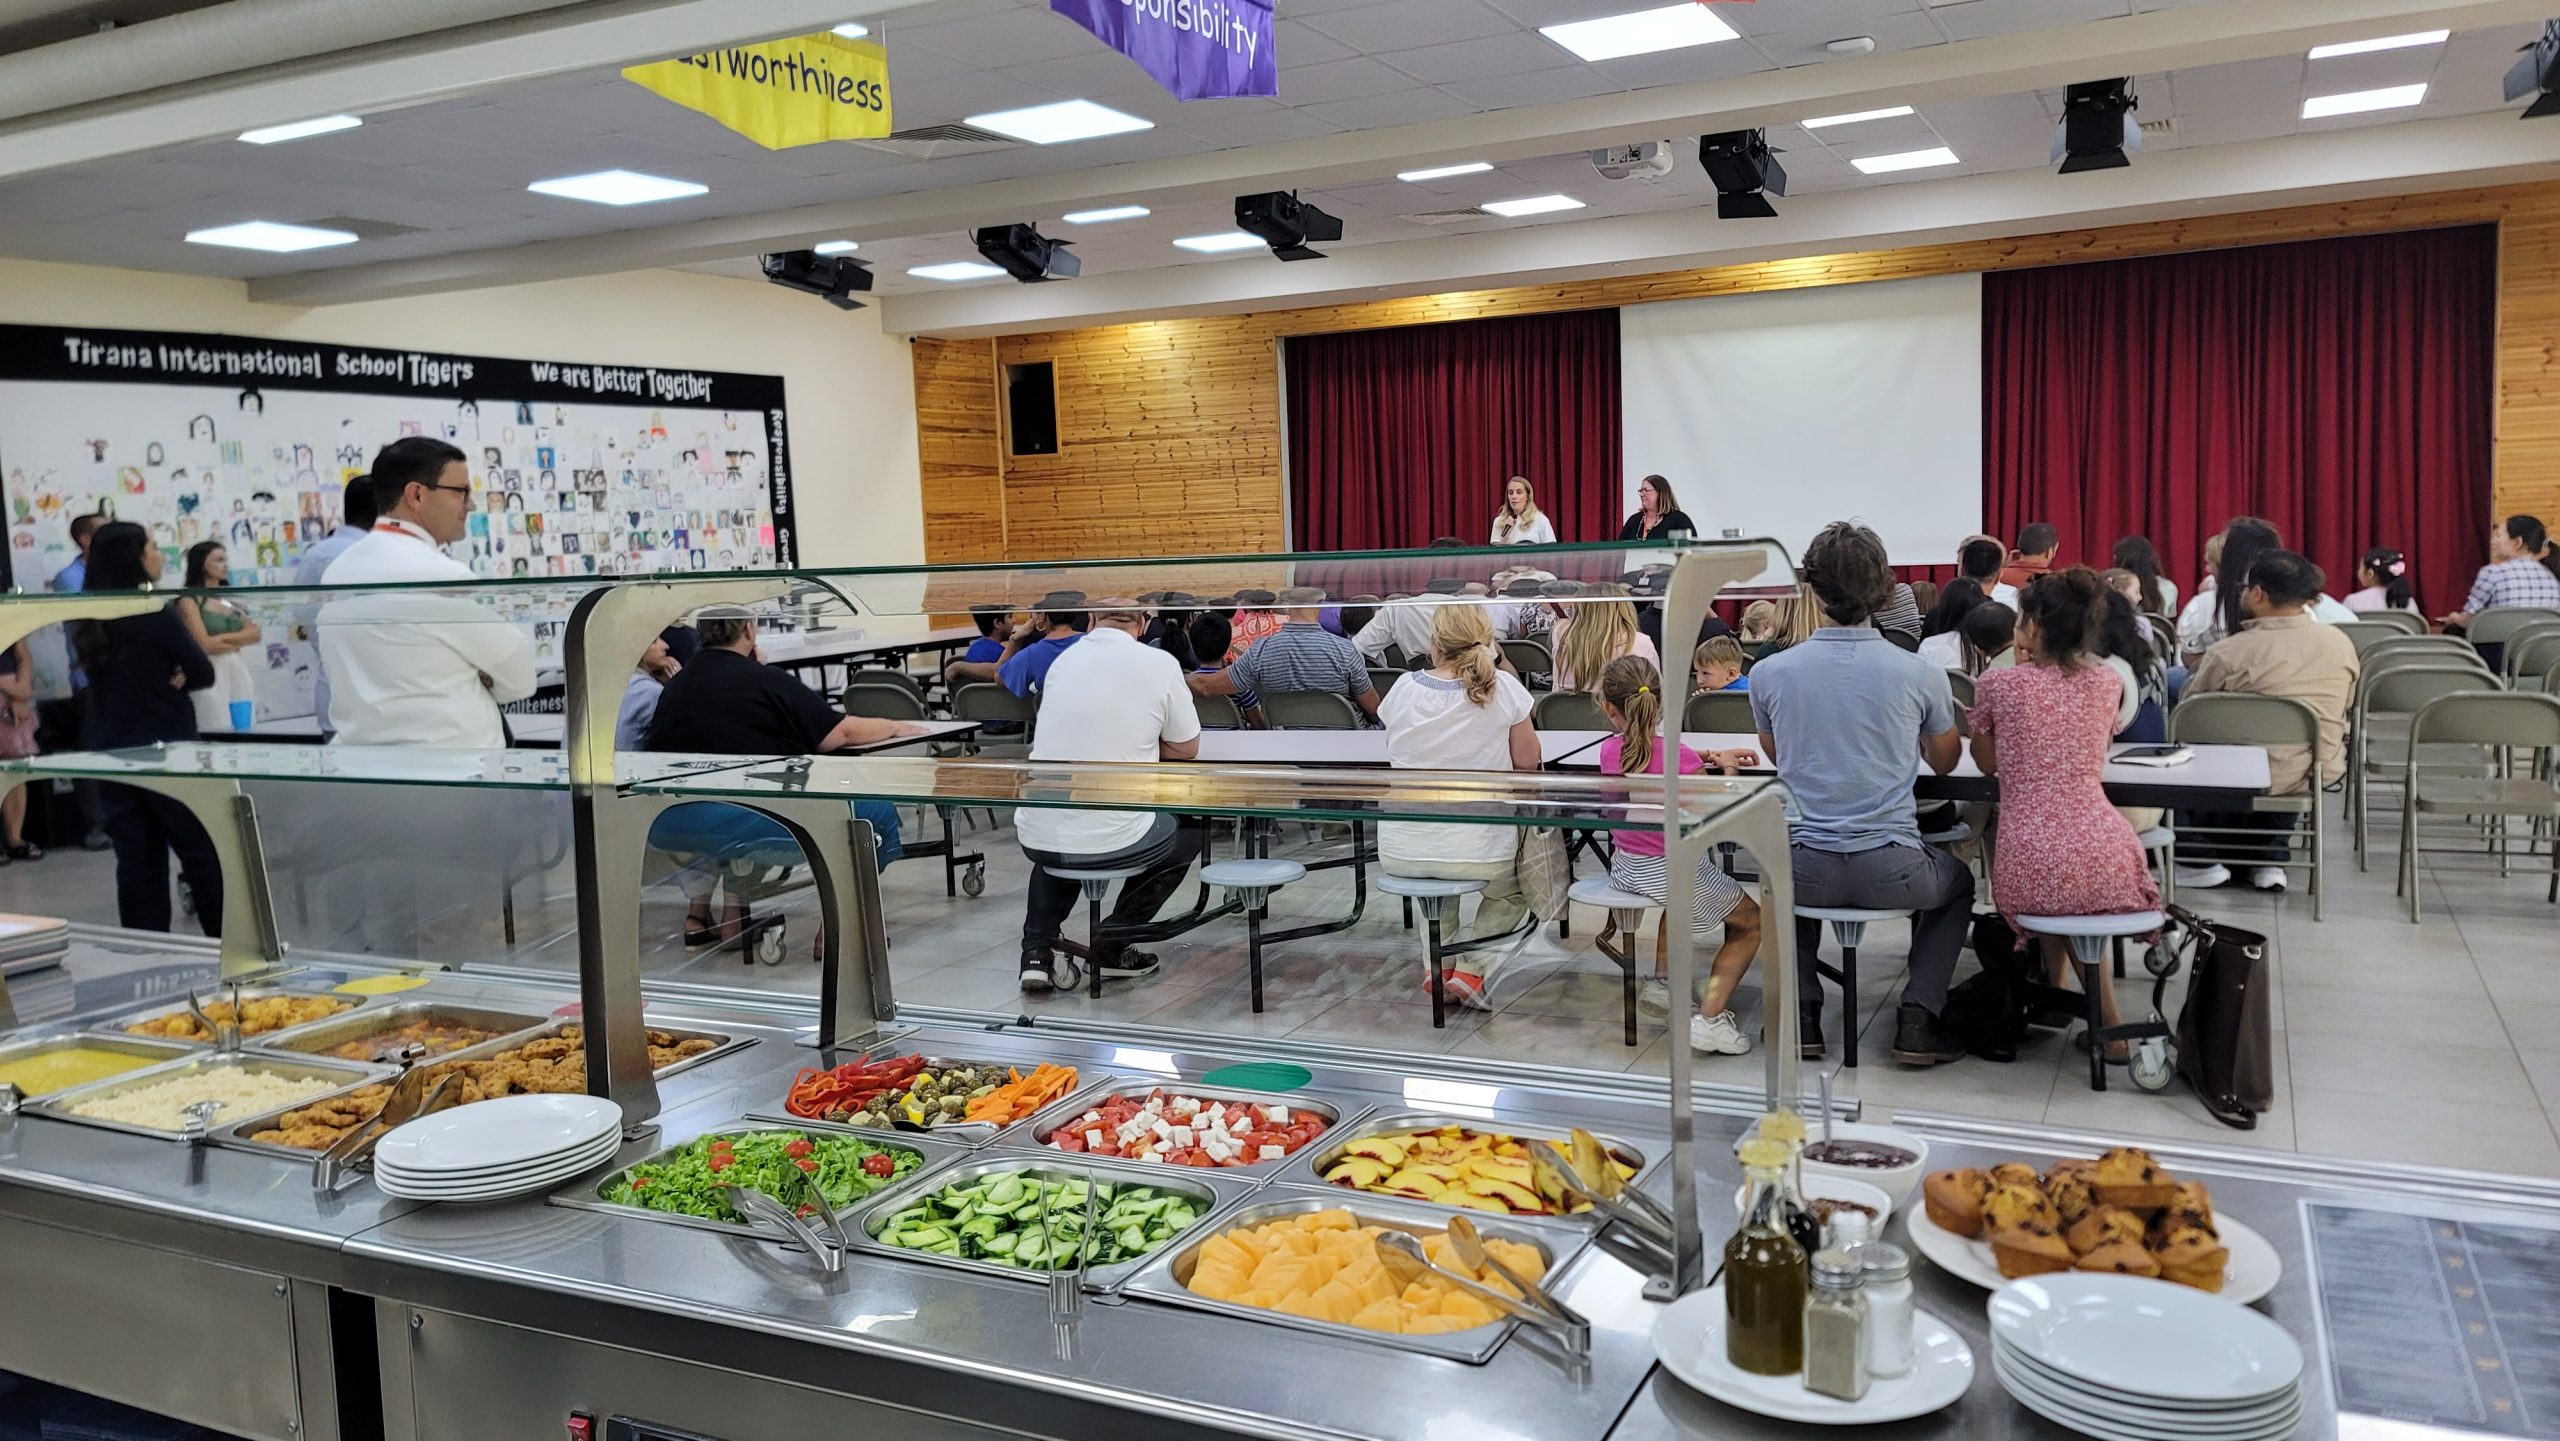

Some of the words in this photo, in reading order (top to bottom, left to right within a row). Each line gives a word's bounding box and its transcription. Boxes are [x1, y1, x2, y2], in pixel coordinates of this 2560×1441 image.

[1121, 0, 1257, 70] ponsibility
[64, 337, 153, 369] Tirana
[159, 344, 322, 379] International
[336, 352, 402, 382] School
[407, 353, 474, 388] Tigers
[531, 362, 559, 382] We
[562, 367, 590, 388] are
[593, 367, 644, 396] Better
[646, 369, 713, 402] Together
[770, 409, 787, 514] Responsibility
[779, 527, 790, 562] Grou
[501, 696, 566, 714] oliteness
